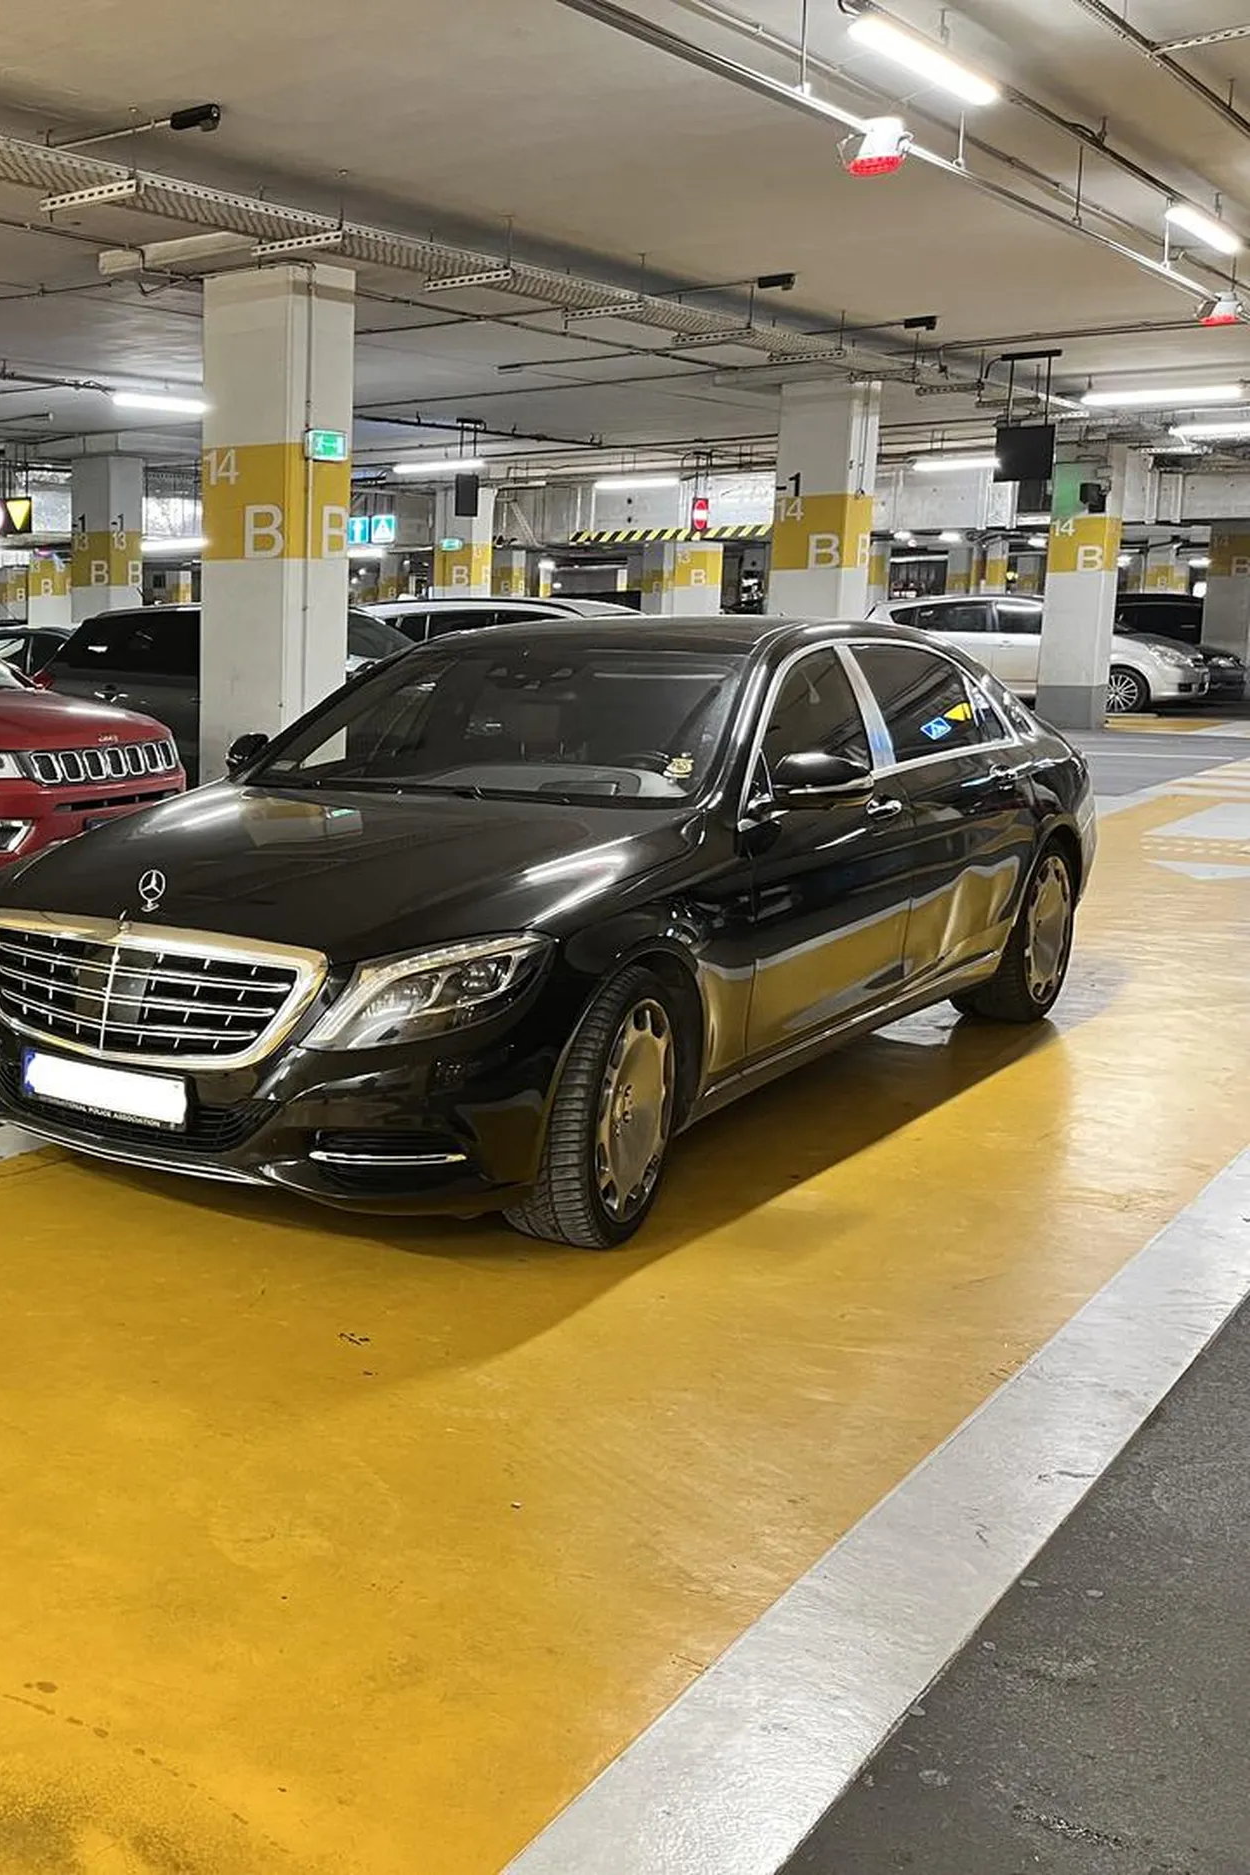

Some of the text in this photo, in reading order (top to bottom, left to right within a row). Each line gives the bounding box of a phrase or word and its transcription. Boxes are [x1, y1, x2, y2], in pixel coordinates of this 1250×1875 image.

[203, 450, 240, 486] 14
[775, 472, 801, 497] -1
[776, 498, 804, 522] 14
[72, 513, 86, 532] -1
[111, 513, 124, 532] -1
[244, 503, 285, 559] B
[1052, 518, 1076, 537] 14
[73, 532, 89, 552] 13
[112, 531, 126, 550] 13
[808, 533, 840, 569] B
[1077, 545, 1104, 572] B
[91, 560, 109, 586] B
[128, 561, 143, 587] B
[452, 565, 469, 586] B
[691, 568, 706, 586] B
